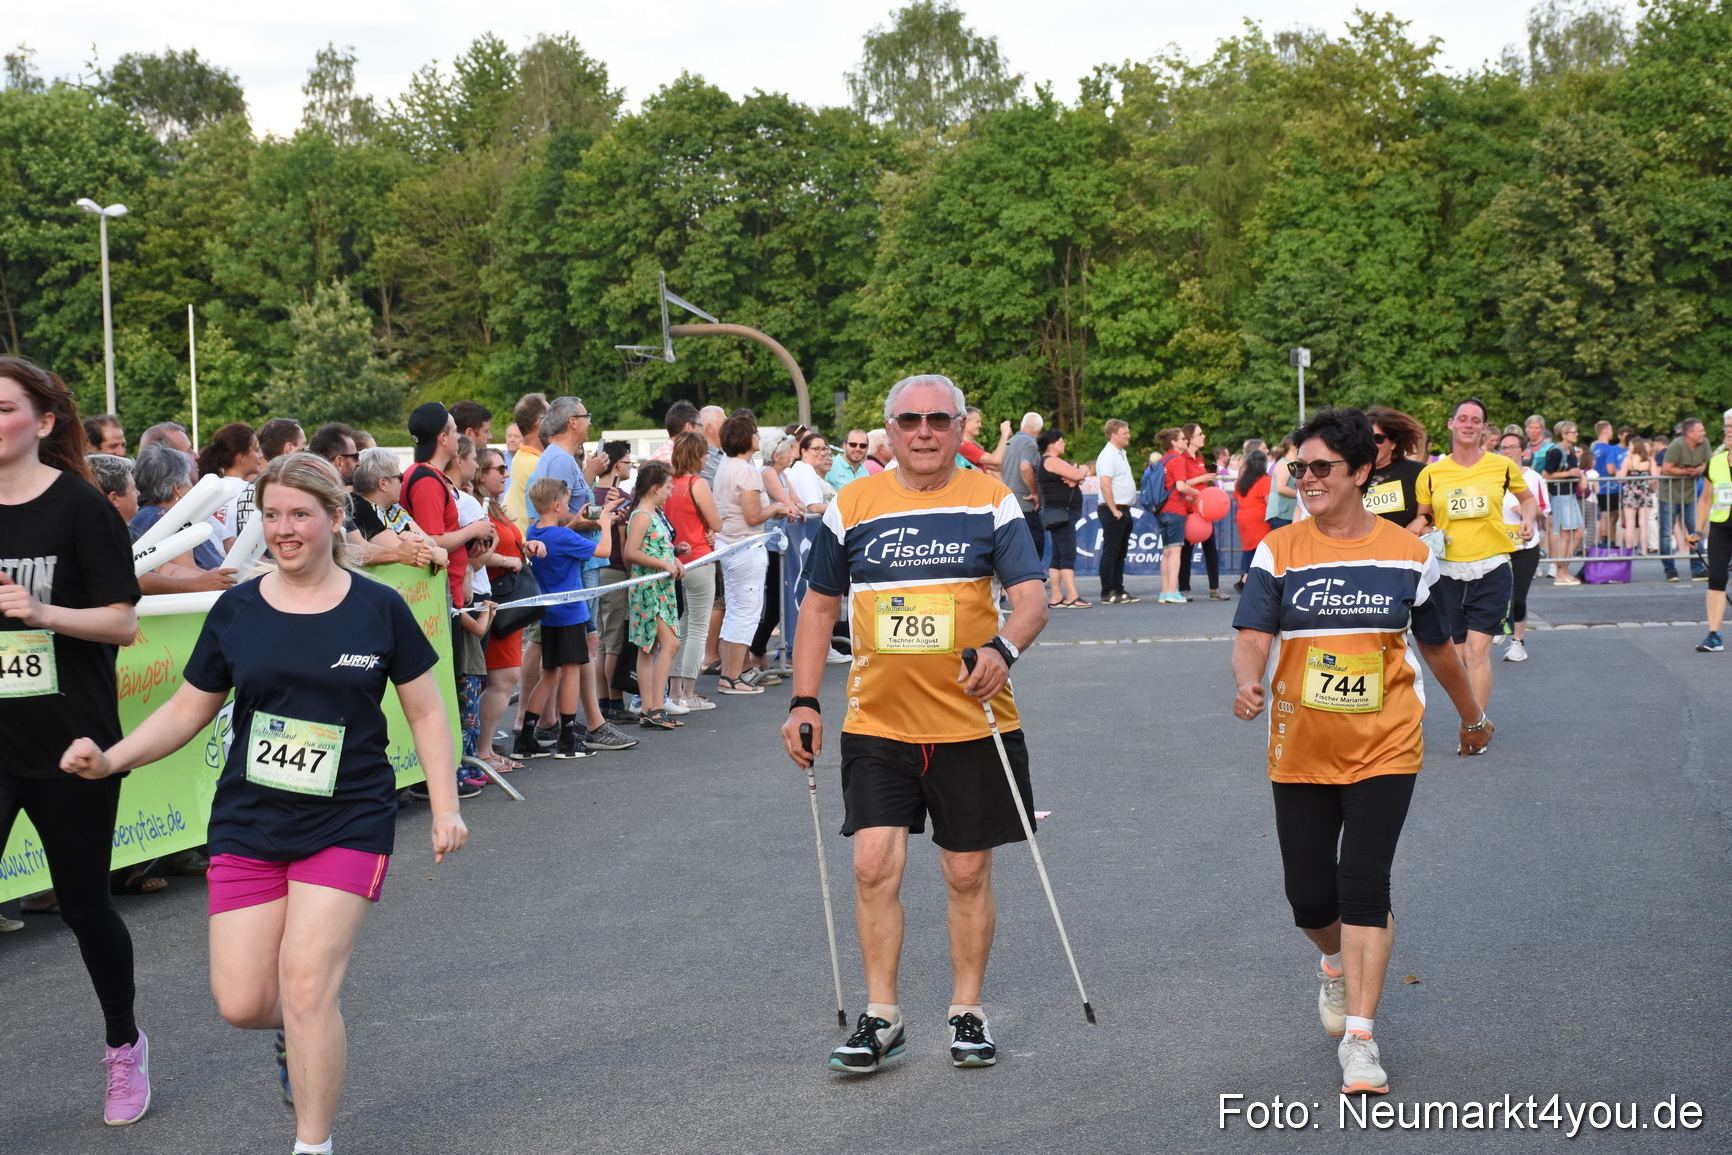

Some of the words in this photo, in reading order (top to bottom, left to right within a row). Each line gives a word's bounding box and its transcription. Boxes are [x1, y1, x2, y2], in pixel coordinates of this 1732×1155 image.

[1365, 492, 1397, 508] 2008
[1451, 497, 1485, 510] 2013
[881, 539, 970, 559] Fischer
[890, 556, 965, 568] AUTOMOBILE
[0, 555, 58, 604] TON
[1309, 590, 1393, 606] Fischer
[1317, 607, 1389, 616] AUTOMOBILE
[890, 615, 936, 637] 786
[916, 637, 939, 645] August
[1320, 672, 1367, 697] 744
[1315, 693, 1338, 702] Fischer
[256, 740, 327, 774] 2447
